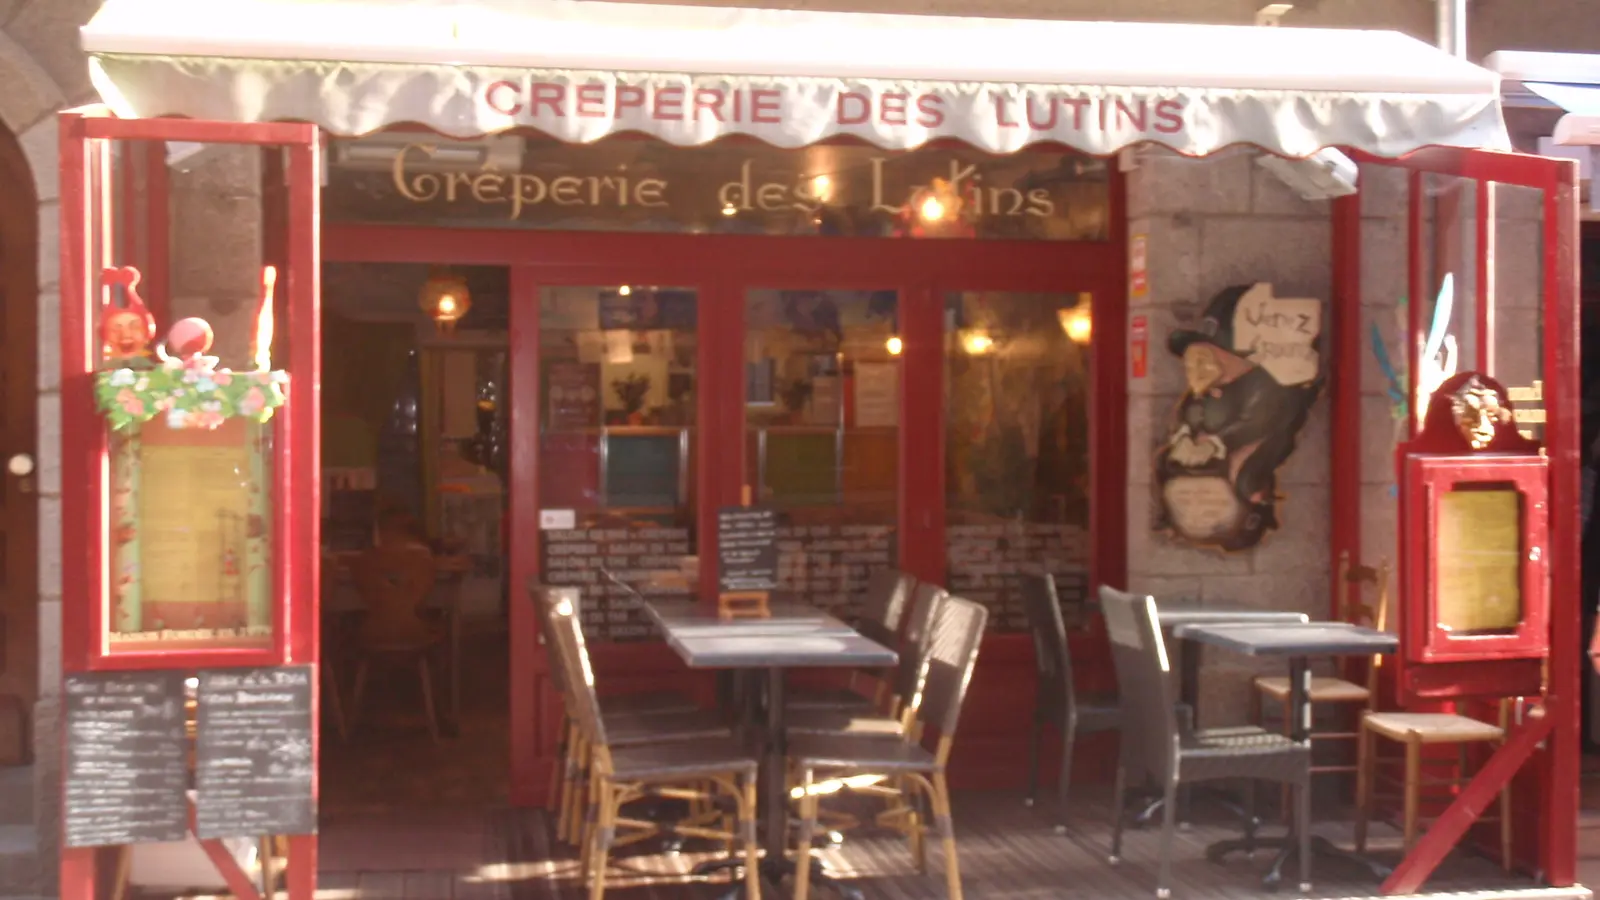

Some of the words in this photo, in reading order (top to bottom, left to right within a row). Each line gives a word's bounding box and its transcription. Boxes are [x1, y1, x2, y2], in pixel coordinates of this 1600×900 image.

[485, 79, 782, 124] CREPERIE
[836, 90, 945, 128] DES
[993, 93, 1185, 134] LUTINS
[392, 143, 670, 220] Crêperie
[718, 158, 822, 212] des
